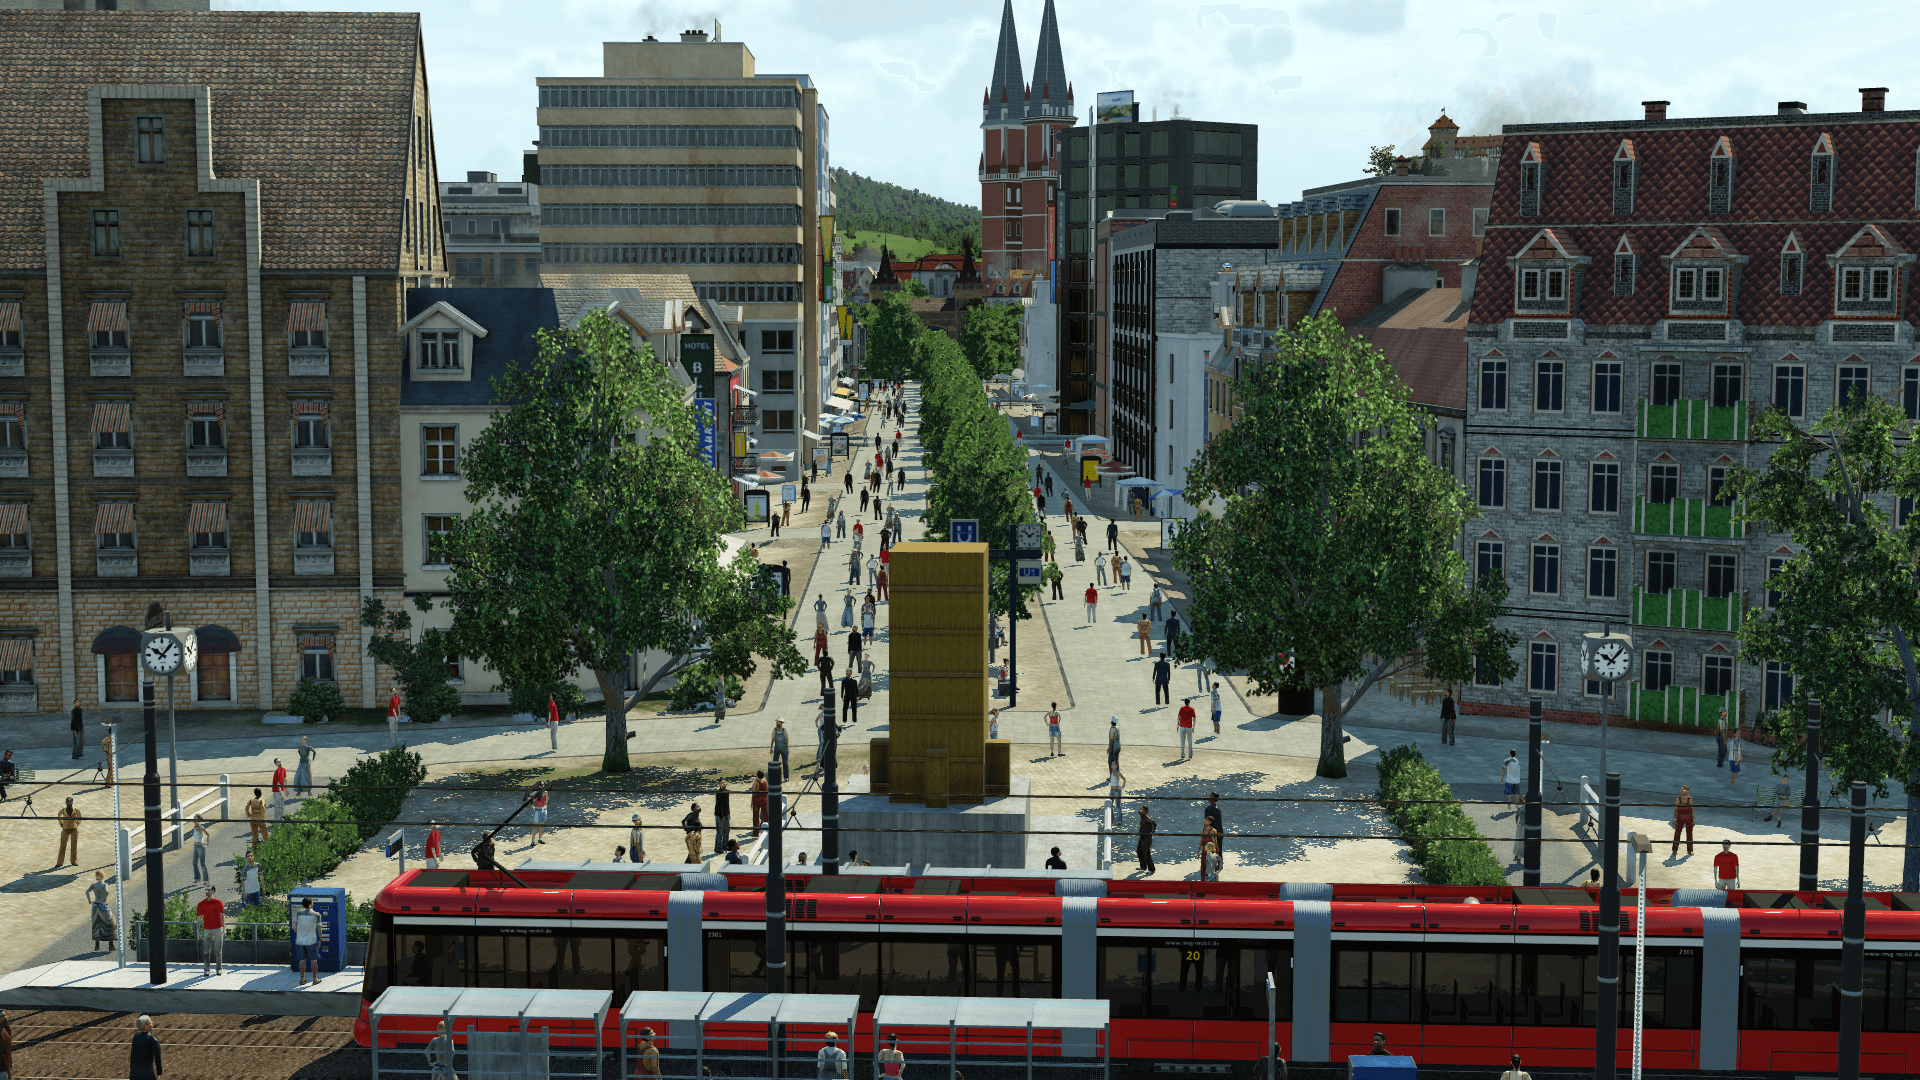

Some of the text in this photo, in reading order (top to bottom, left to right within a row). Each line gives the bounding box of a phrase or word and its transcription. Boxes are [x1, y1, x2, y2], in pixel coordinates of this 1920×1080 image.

[685, 342, 710, 350] HOTEL
[1023, 567, 1035, 577] U1
[1186, 950, 1201, 961] 20
